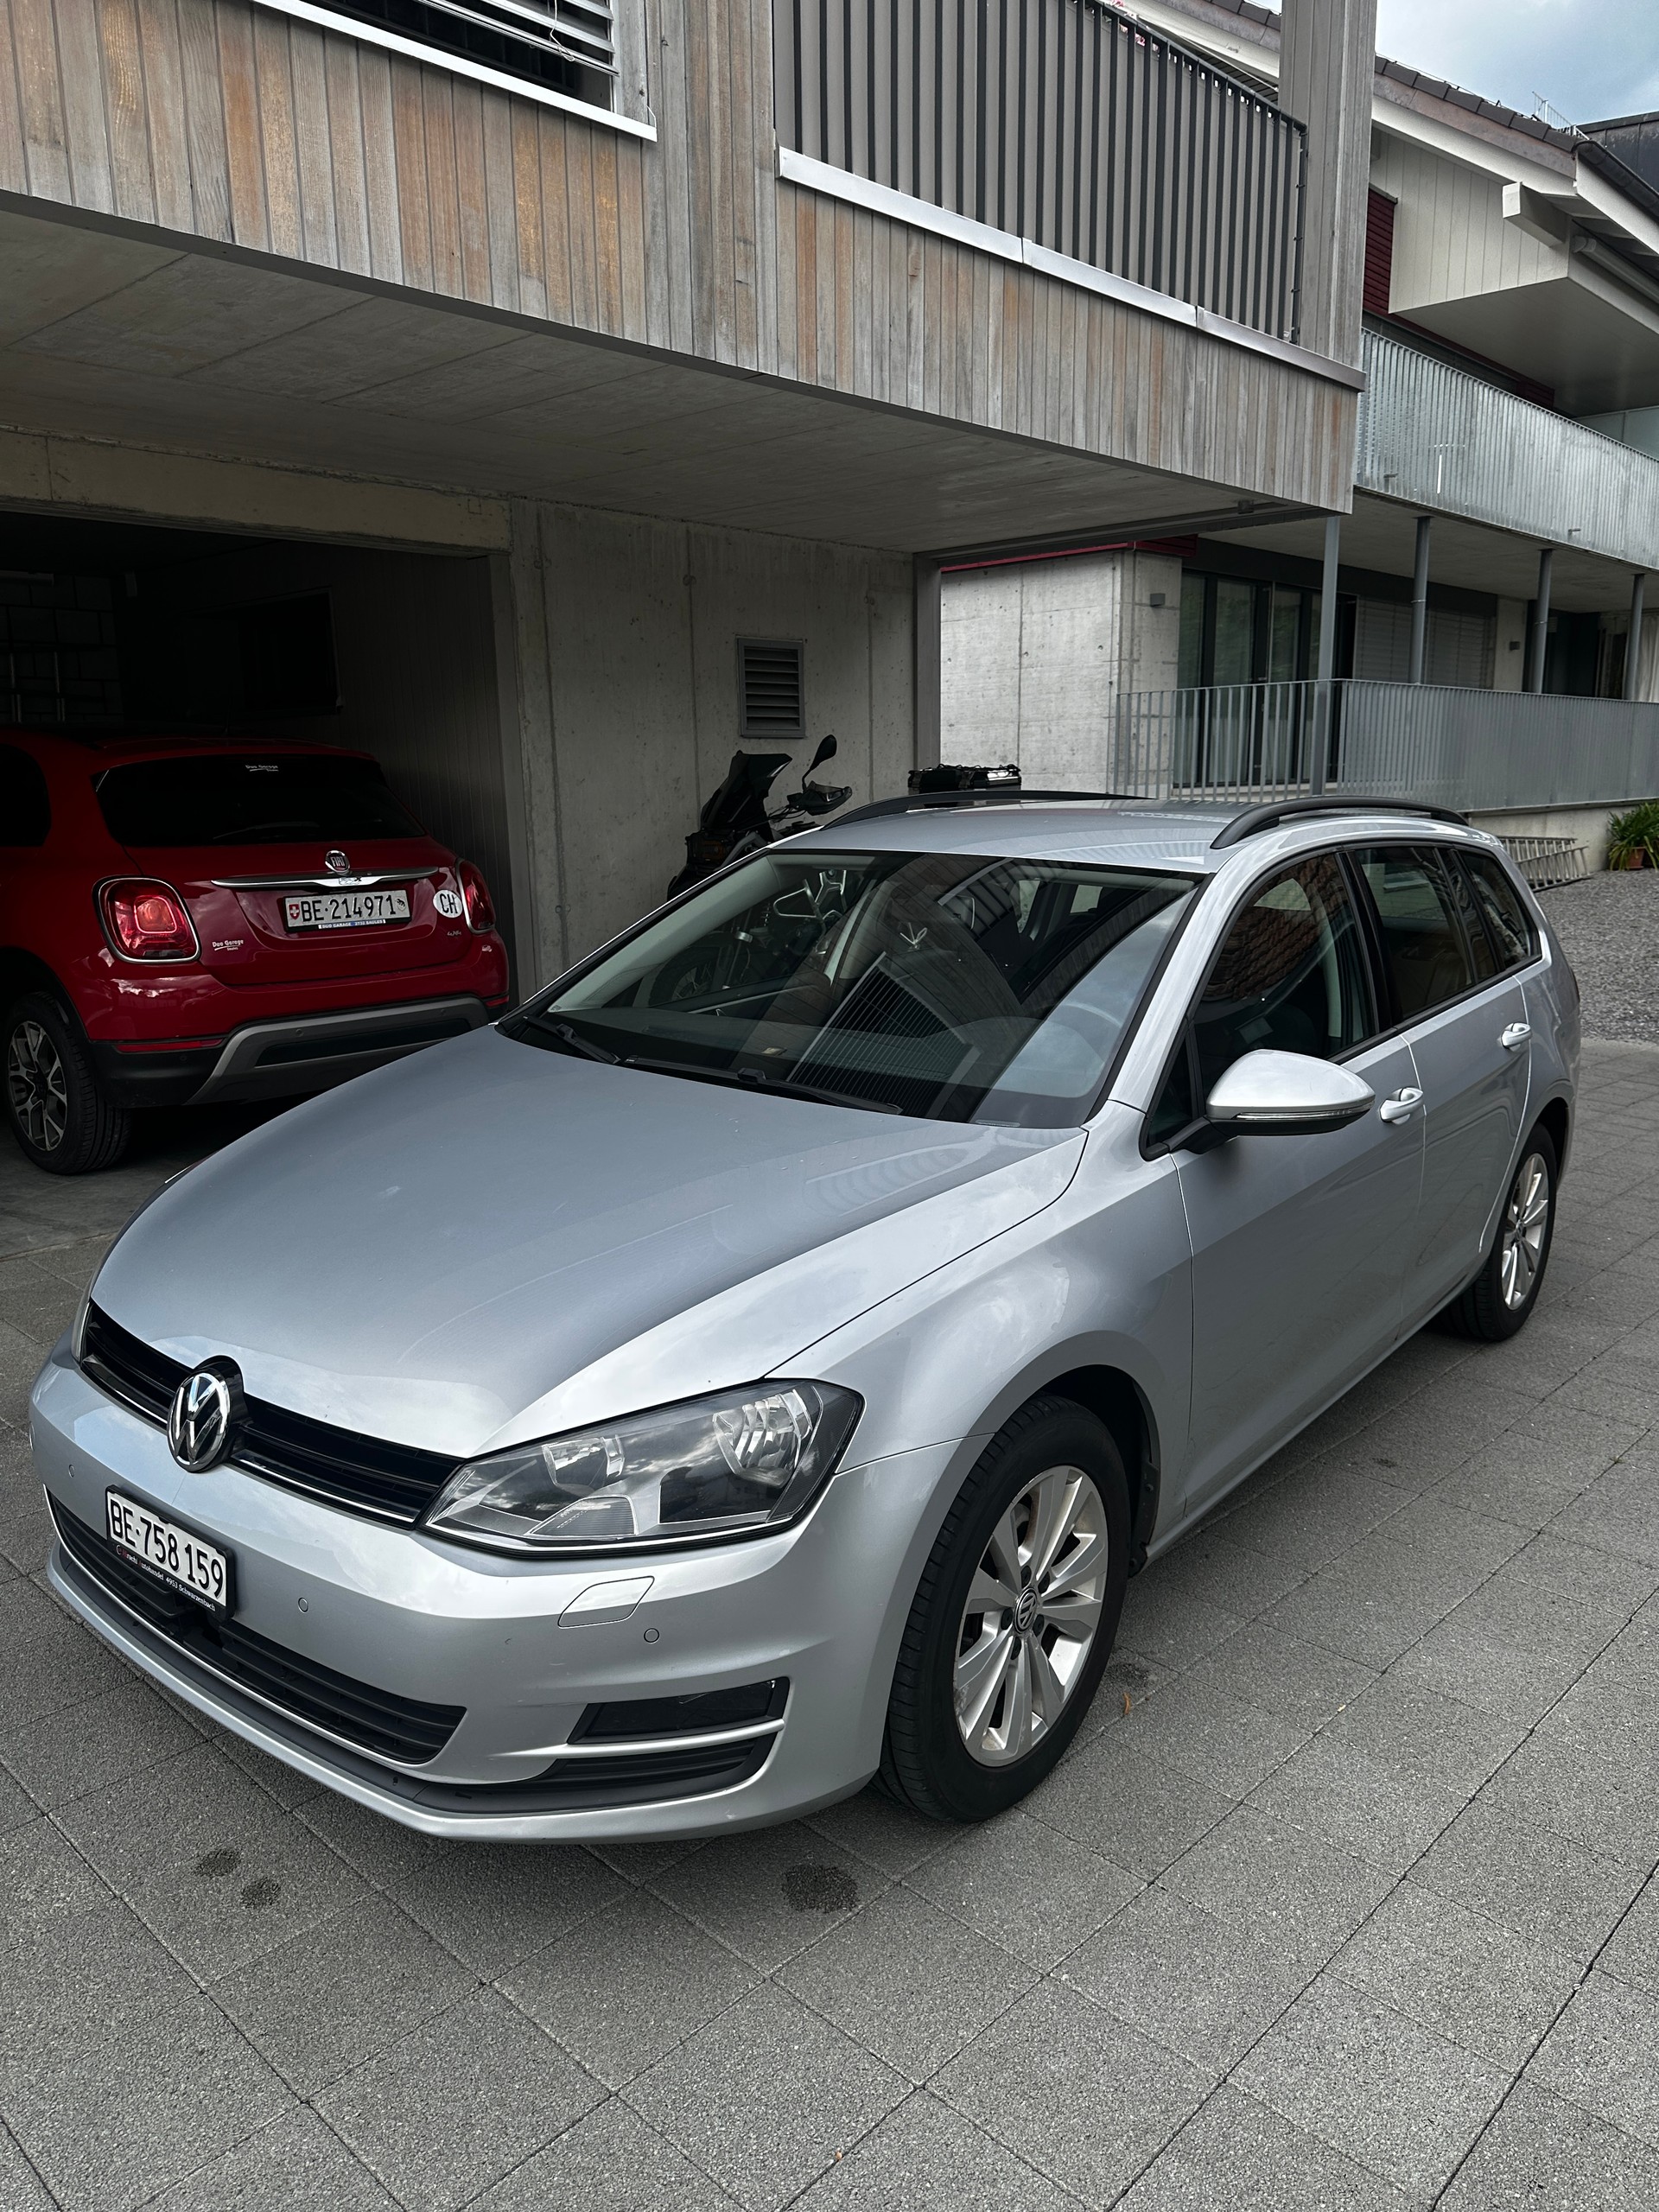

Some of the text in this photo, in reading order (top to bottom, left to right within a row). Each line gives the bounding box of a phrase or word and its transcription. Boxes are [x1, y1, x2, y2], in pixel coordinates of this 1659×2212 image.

[330, 856, 346, 868] FIAT
[440, 893, 458, 914] CH
[185, 1543, 223, 1598] 159
[166, 1577, 178, 1589] 4953
[178, 1584, 216, 1612] Schwarzenbach
